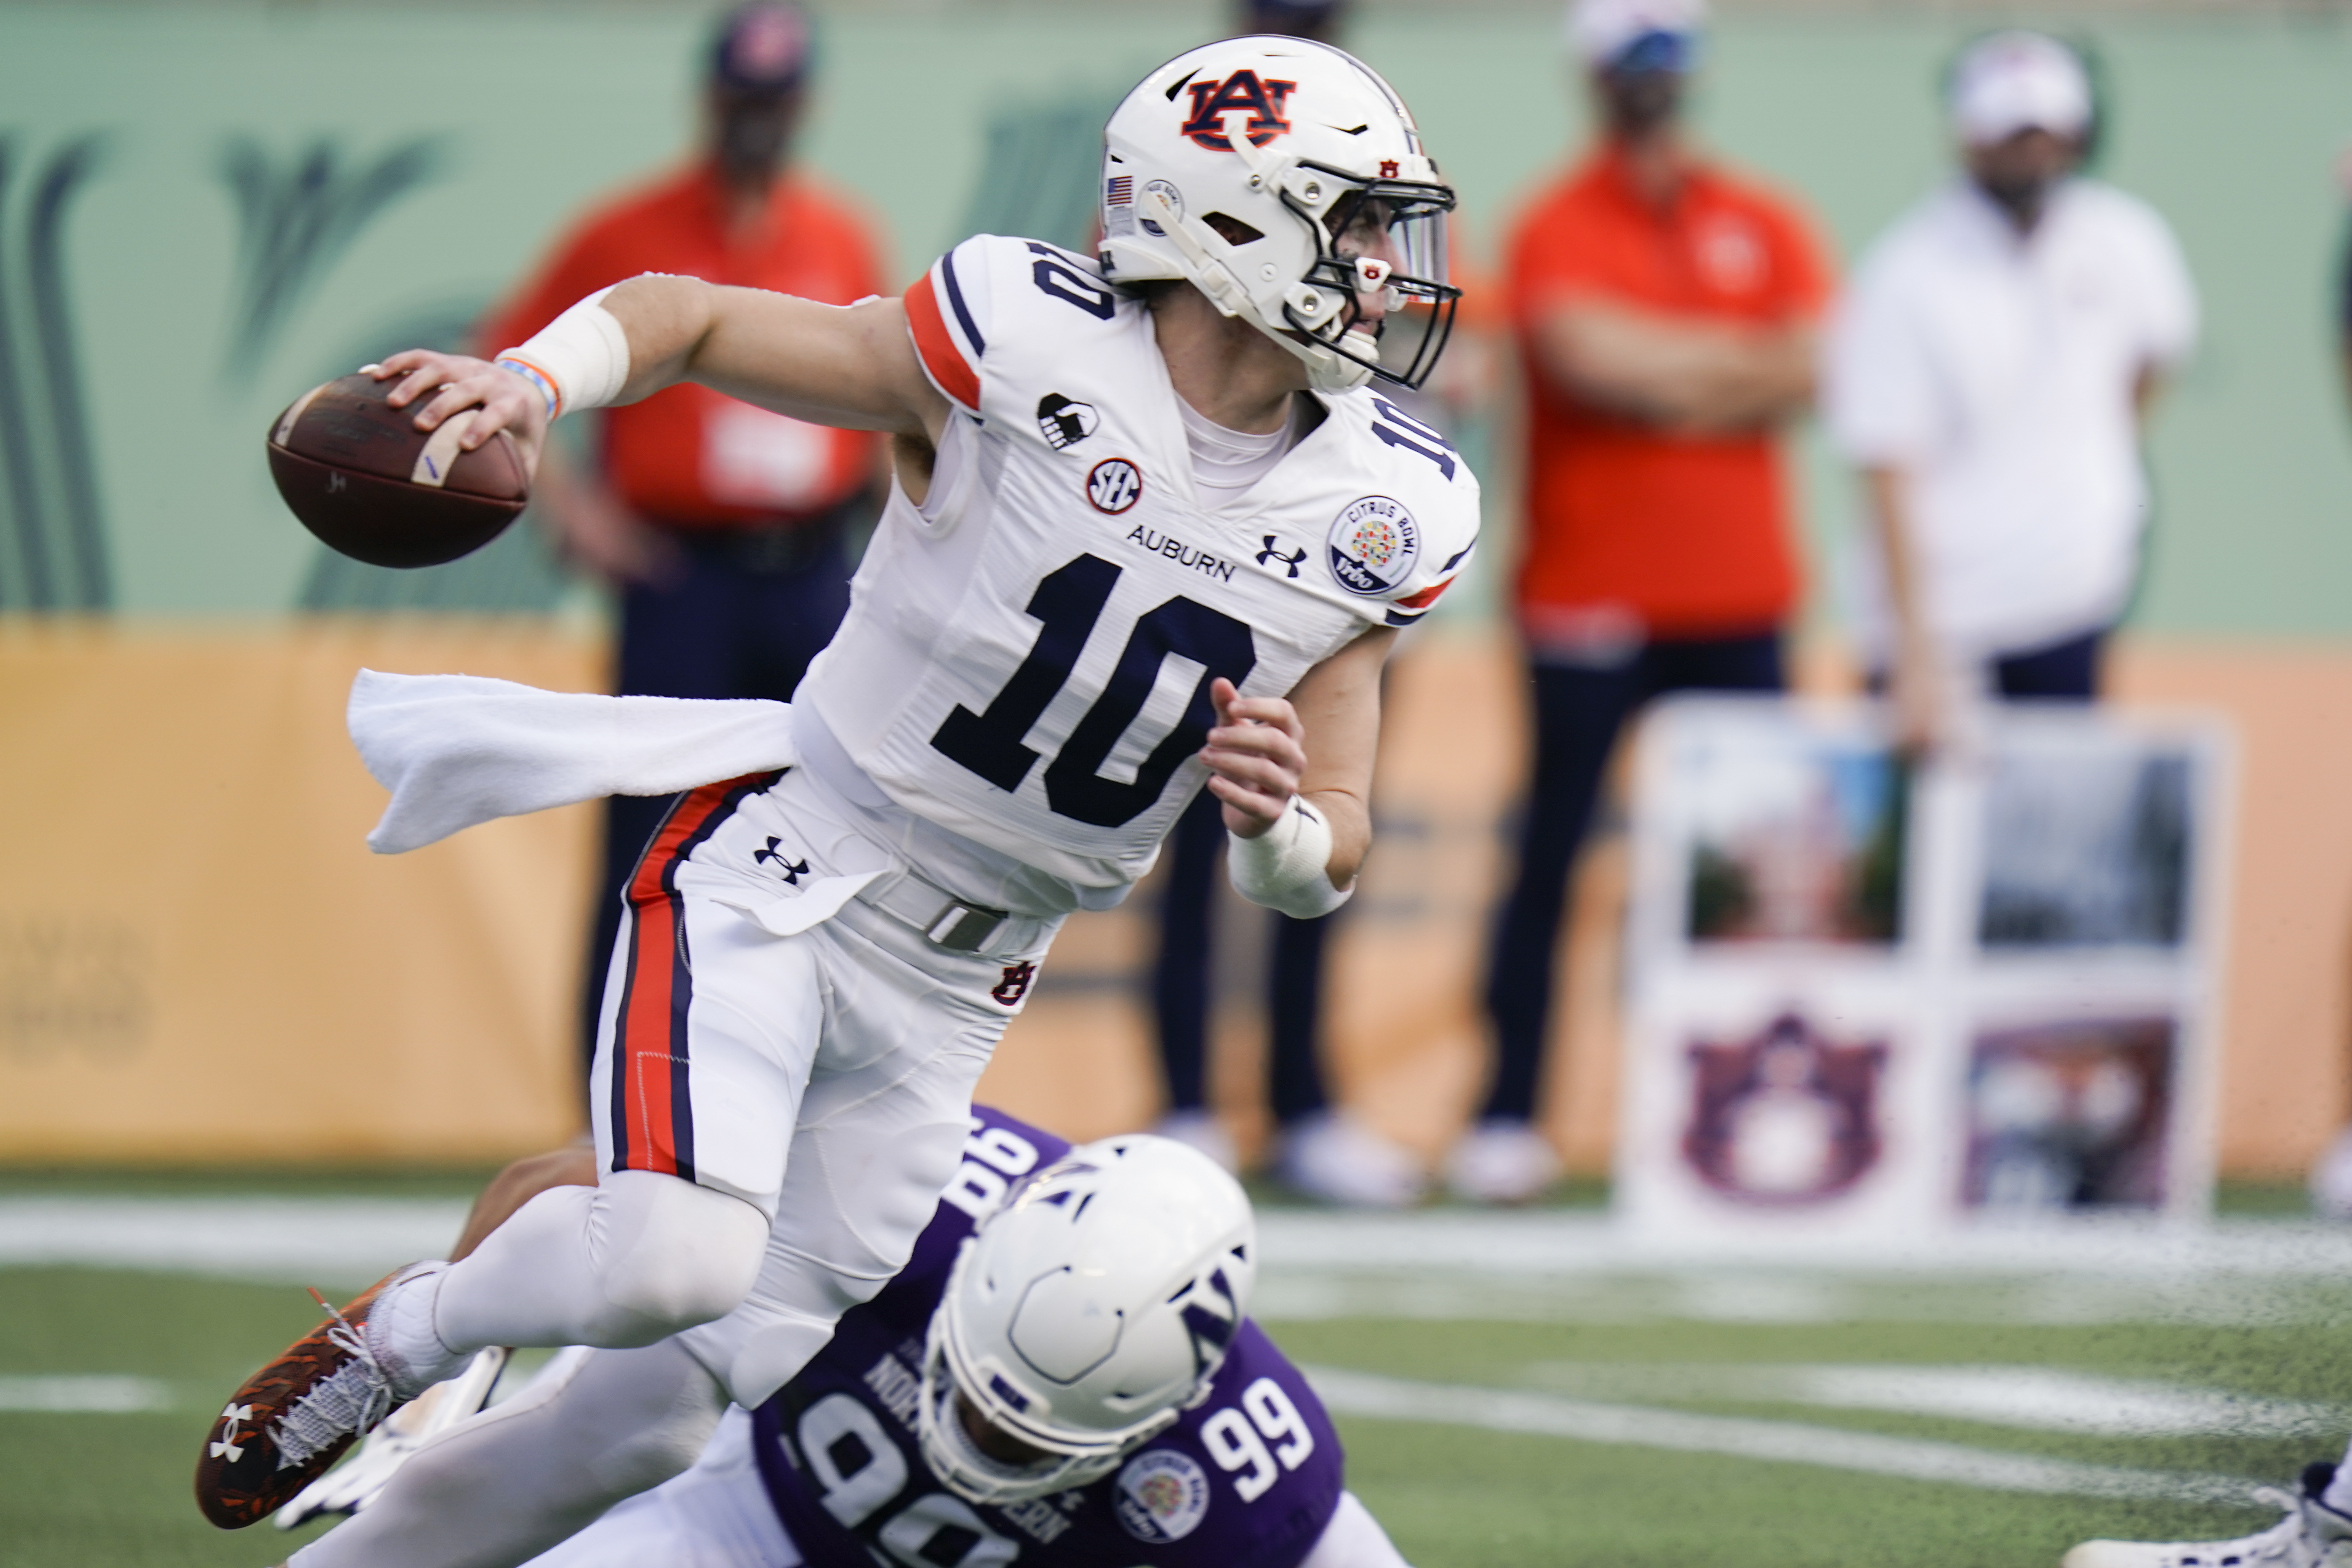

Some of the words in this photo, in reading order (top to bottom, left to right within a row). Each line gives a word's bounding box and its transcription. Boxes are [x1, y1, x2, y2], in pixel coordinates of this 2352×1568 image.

[1089, 462, 1141, 511] SEC
[1127, 525, 1237, 583] AUBURN
[930, 552, 1257, 828] 10
[1199, 1377, 1314, 1503] 99
